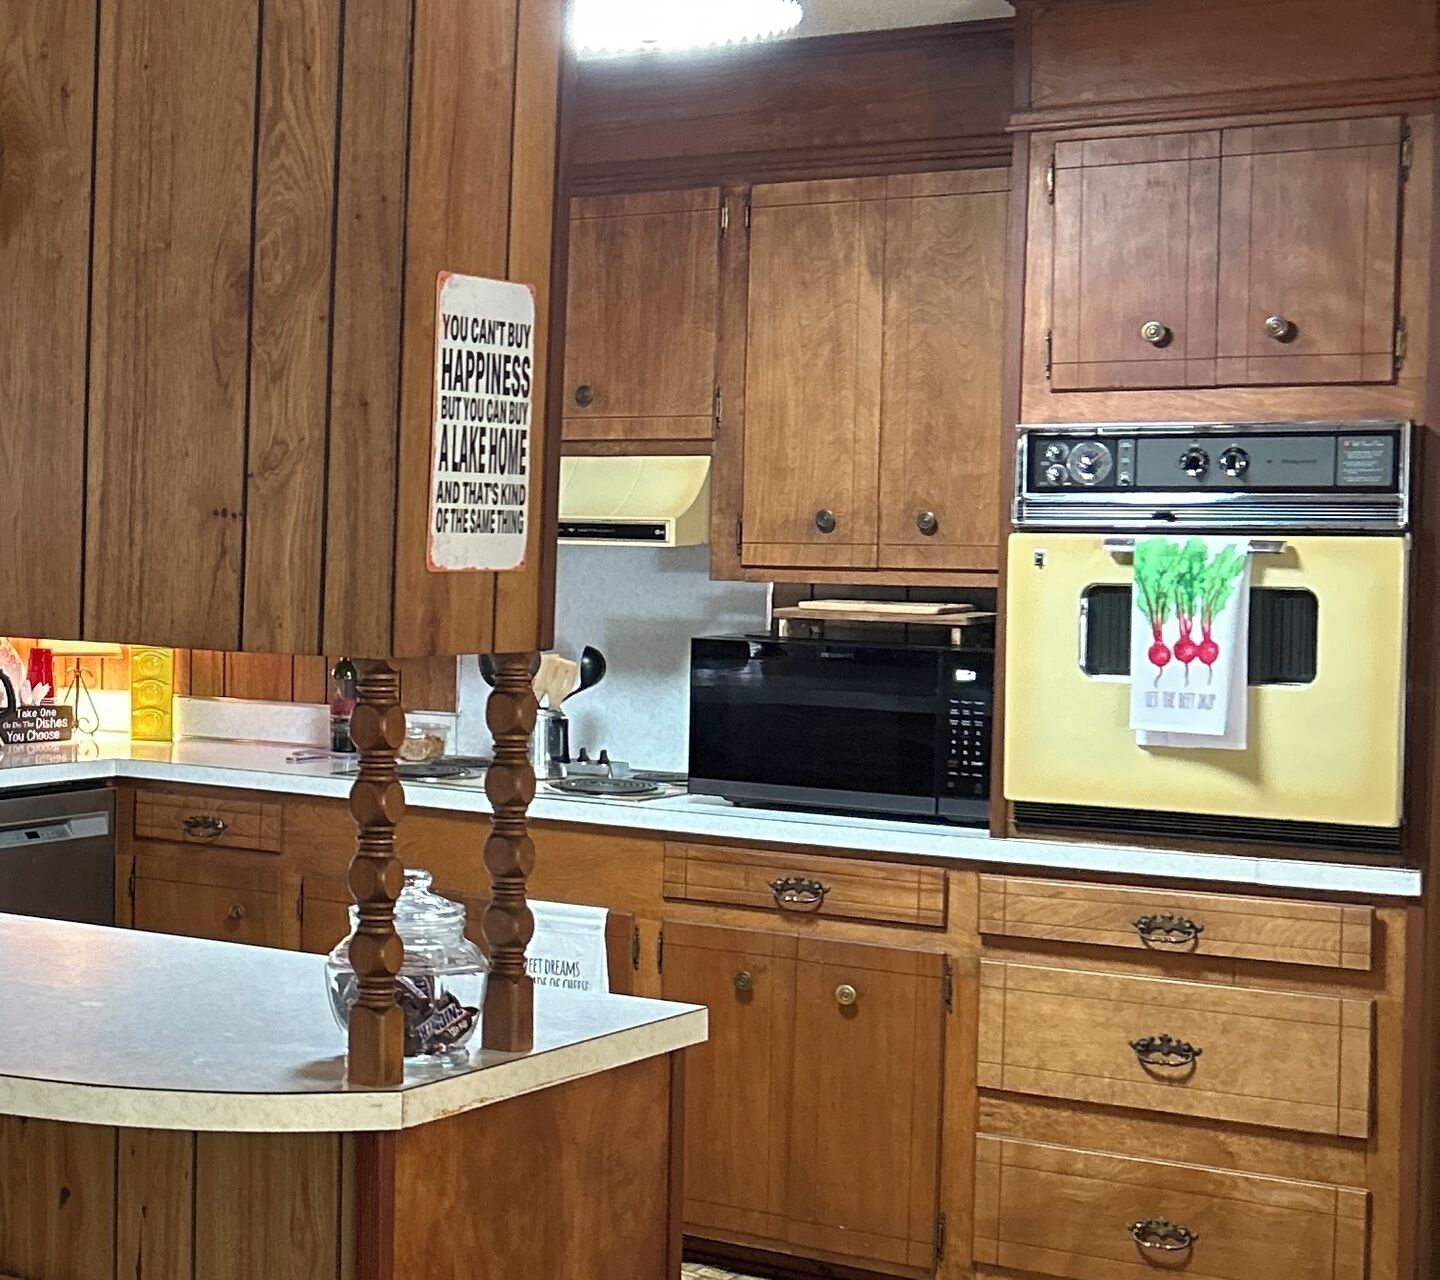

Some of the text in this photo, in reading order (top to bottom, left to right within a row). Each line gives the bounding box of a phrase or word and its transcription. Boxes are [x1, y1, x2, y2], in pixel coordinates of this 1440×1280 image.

[442, 314, 531, 349] YOU CAN'T BUY
[441, 348, 531, 398] HAPPINESS
[441, 395, 529, 425] BUT YOU CAN BUY
[438, 424, 527, 475] A LAKE HOME
[436, 480, 526, 506] AND THAT'S KIND
[435, 507, 524, 534] OF THE SAME THING
[35, 716, 69, 730] Dishes
[39, 707, 57, 717] One
[6, 729, 61, 742] You Choose
[525, 957, 581, 978] EET DREAMS
